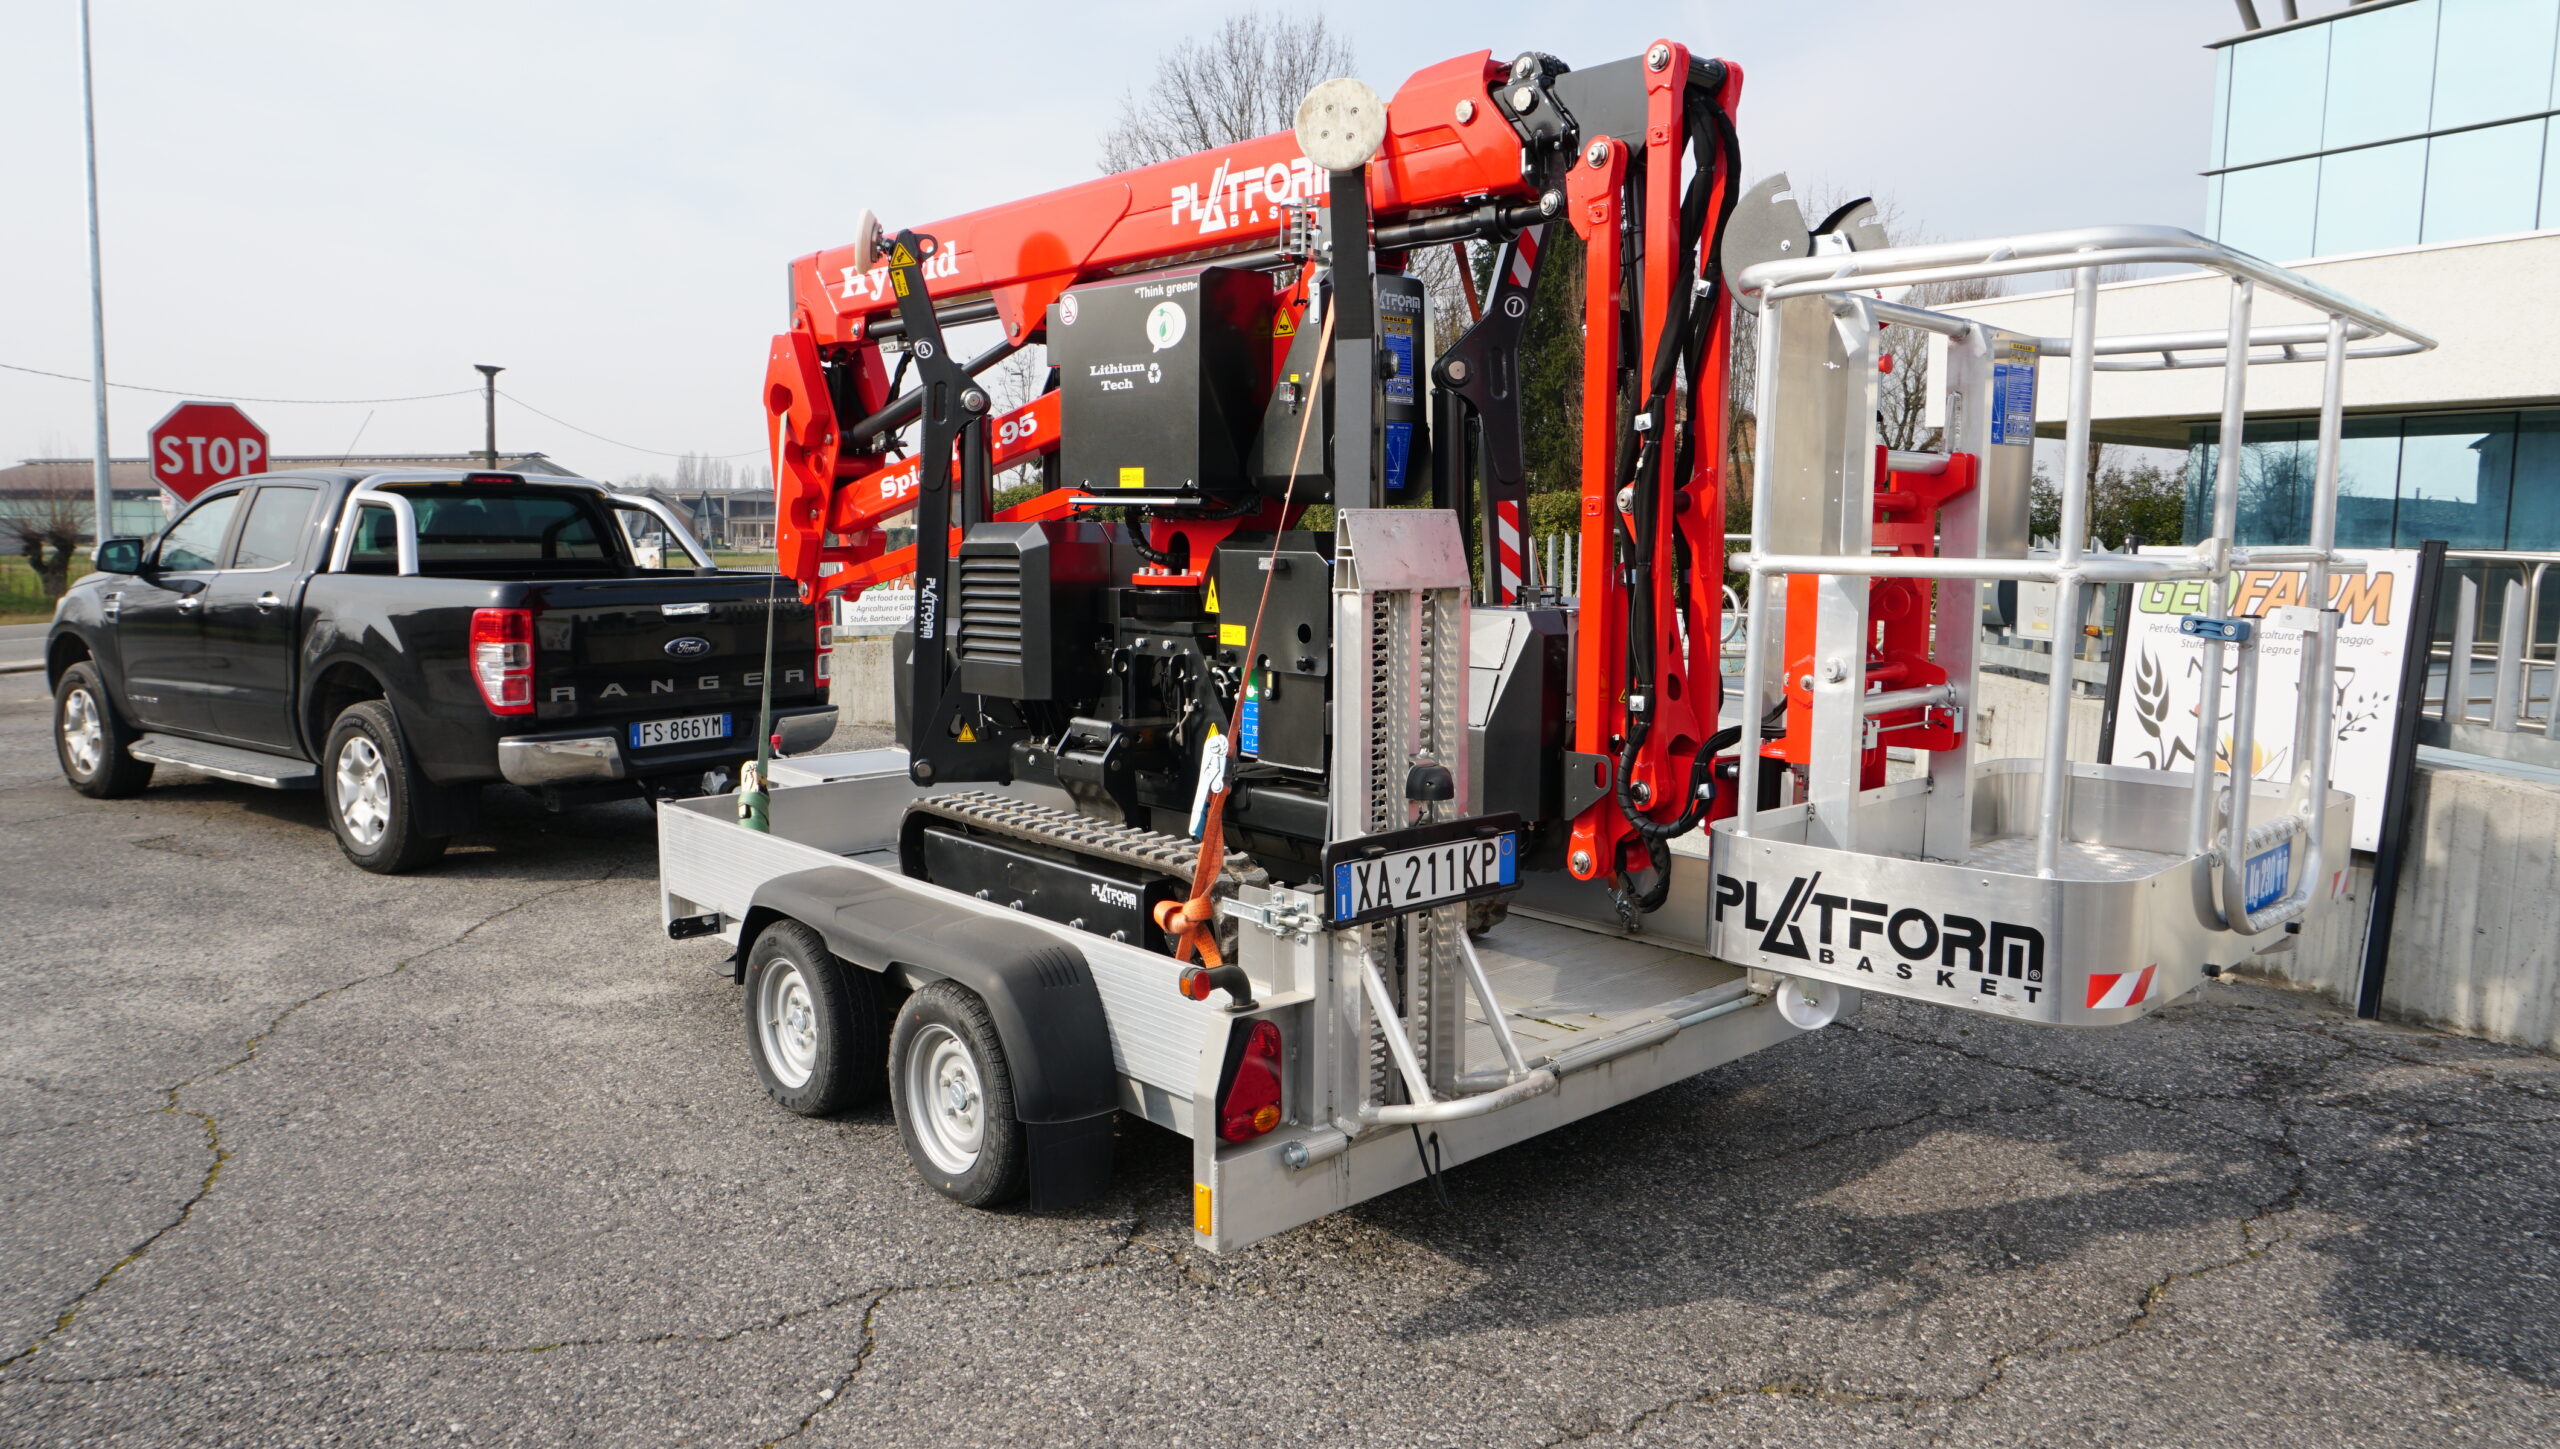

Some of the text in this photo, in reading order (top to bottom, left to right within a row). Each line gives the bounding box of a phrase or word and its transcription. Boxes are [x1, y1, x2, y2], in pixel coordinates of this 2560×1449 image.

[840, 240, 960, 301] Hyid
[1380, 288, 1421, 309] ATFORM
[1089, 362, 1146, 377] Lithium
[1100, 379, 1134, 391] Tech
[159, 435, 262, 476] STOP
[880, 465, 920, 500] Spi
[921, 577, 939, 639] PLATFORM
[677, 640, 702, 654] Ford
[2149, 623, 2163, 634] Pet
[2164, 623, 2181, 635] foo
[2258, 630, 2295, 641] coltura
[2336, 635, 2375, 648] naggio
[2181, 638, 2301, 657] Stufe Legna e
[550, 669, 804, 702] RANGER
[643, 722, 663, 744] FS
[670, 716, 722, 741] 866YM
[1356, 860, 1392, 911] XA
[1405, 842, 1497, 900] 211KP
[1091, 883, 1137, 906] PLATFORM
[1715, 871, 2045, 983] PLATFORM
[1819, 948, 2042, 1003] BASKET
